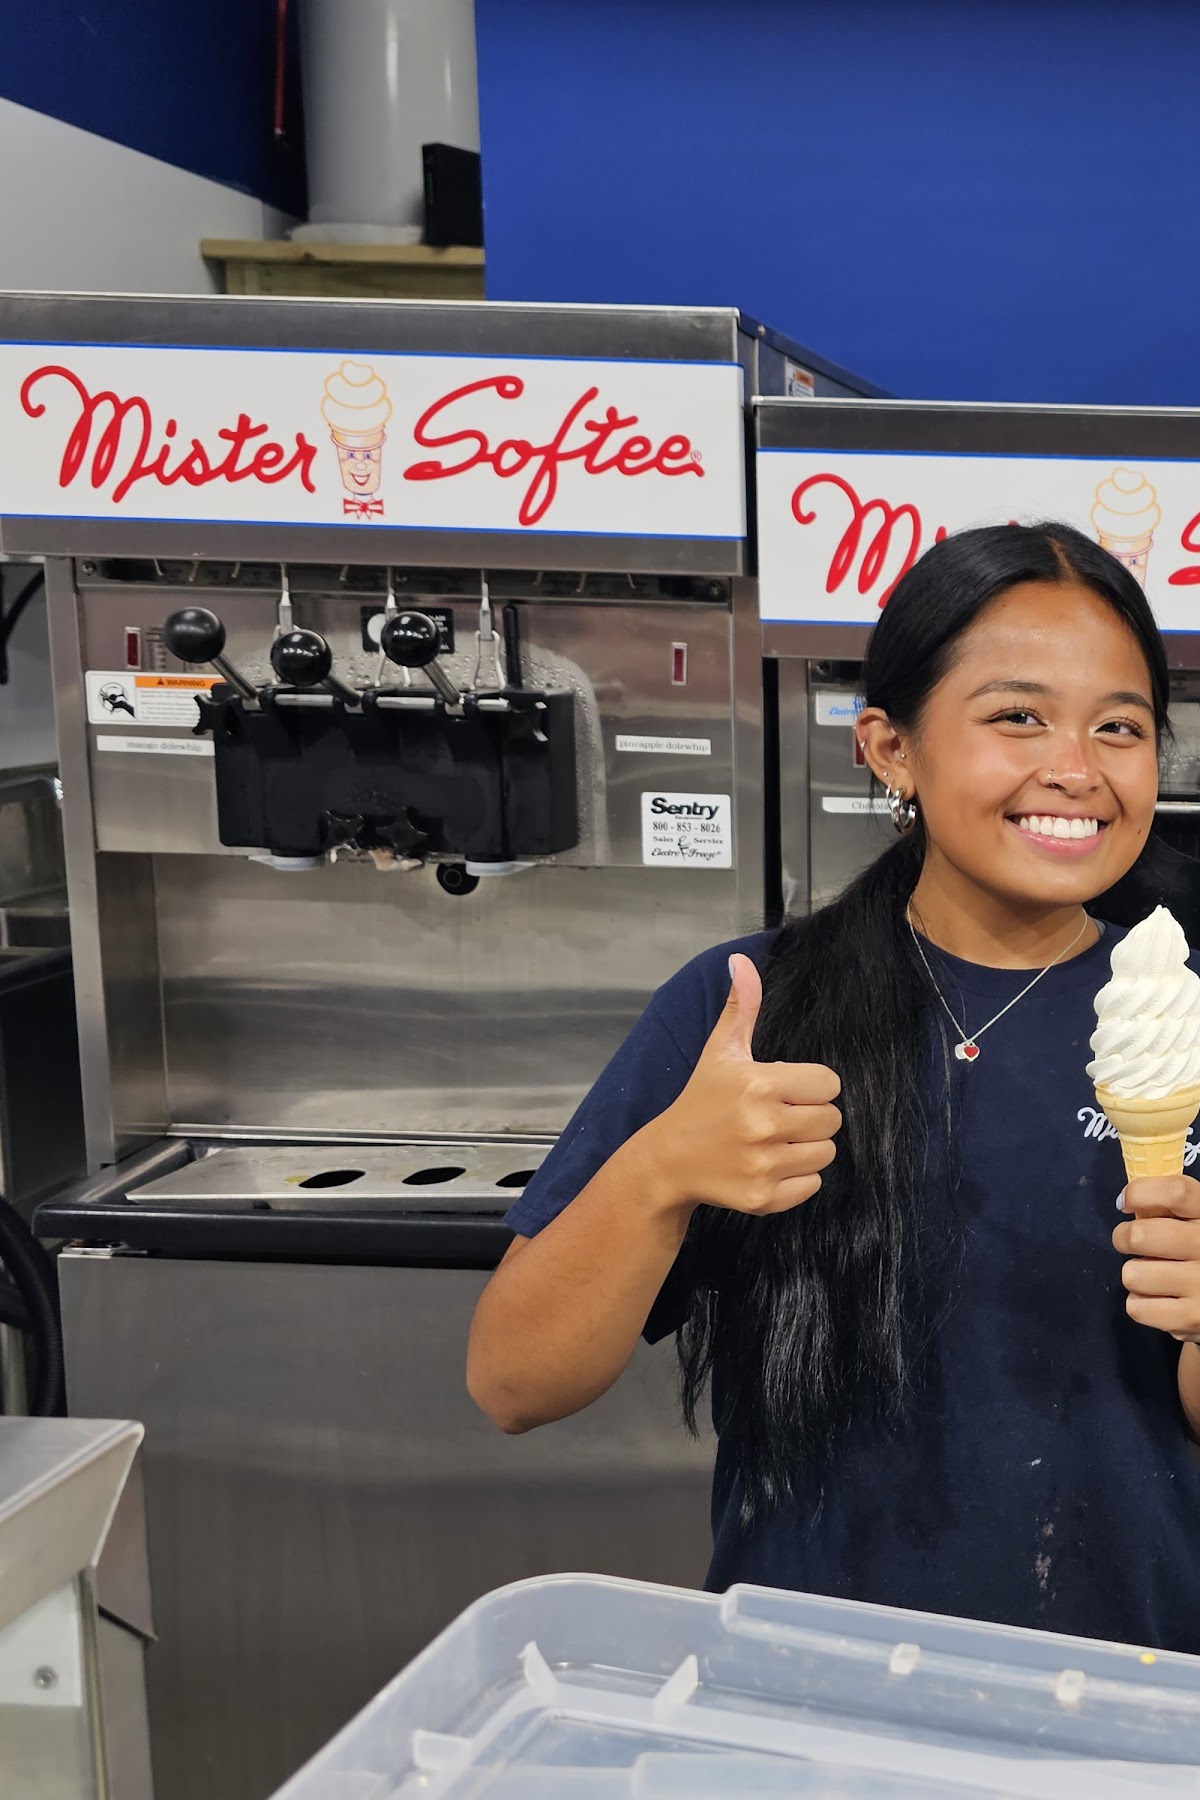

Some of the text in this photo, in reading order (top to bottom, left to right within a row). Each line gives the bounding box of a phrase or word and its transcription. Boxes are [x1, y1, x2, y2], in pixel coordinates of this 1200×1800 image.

[20, 366, 704, 526] Mister Softee
[619, 739, 708, 752] pineapple dolewhip
[650, 797, 720, 820] Sentry
[652, 821, 668, 831] 800
[677, 822, 692, 832] 853
[701, 823, 721, 833] 8026
